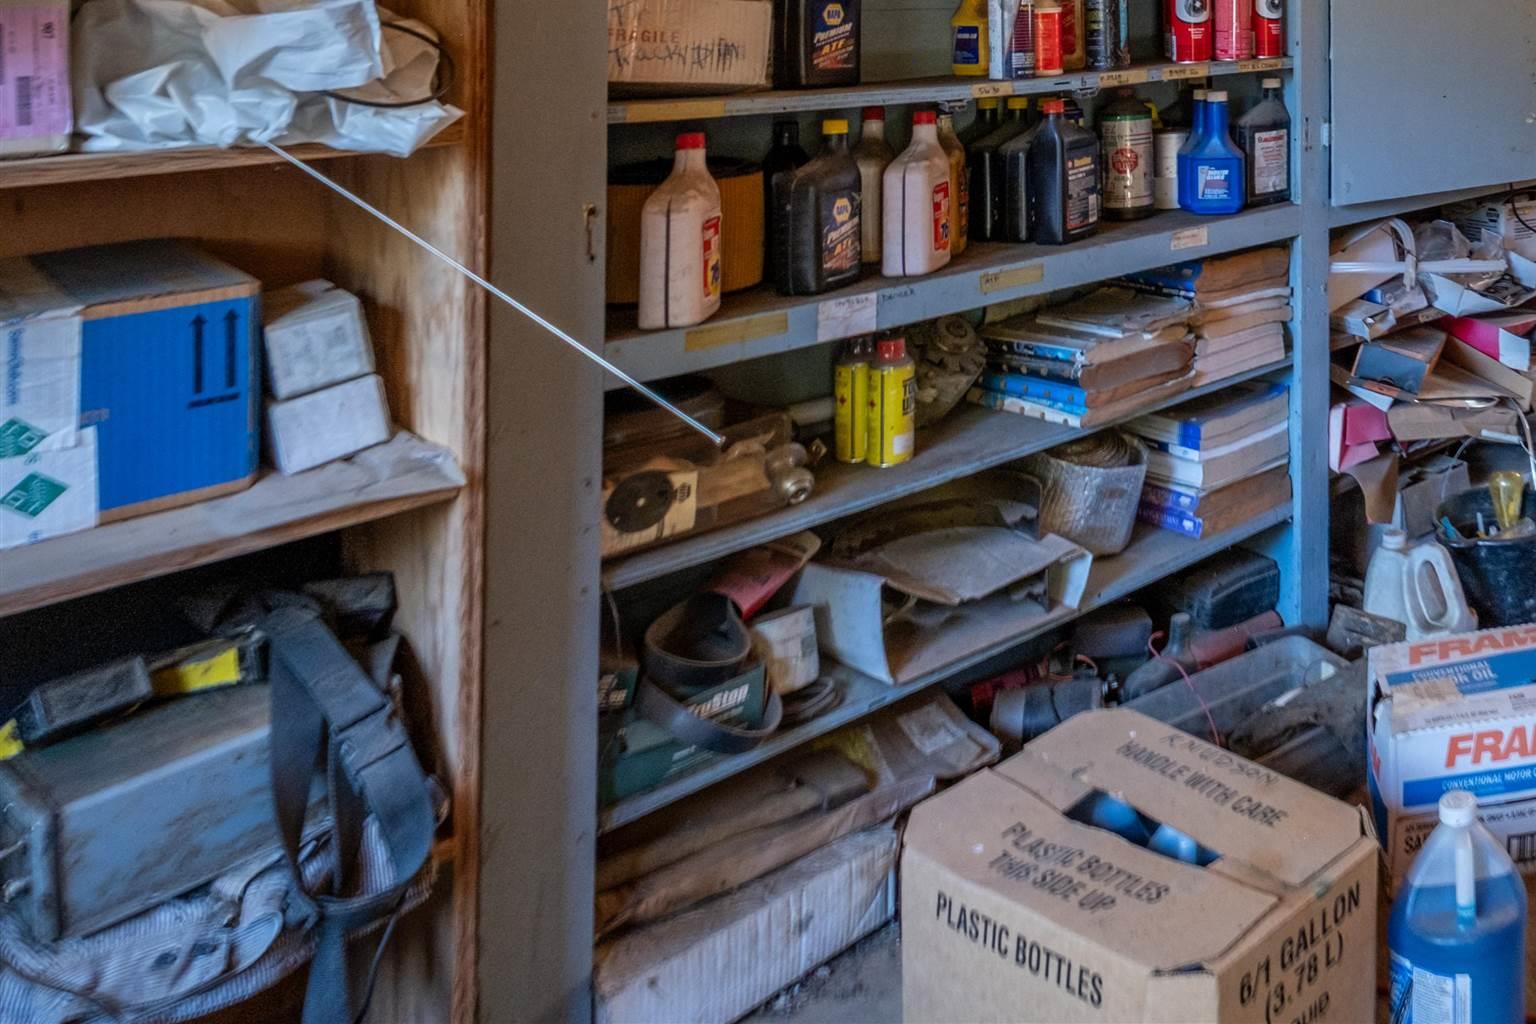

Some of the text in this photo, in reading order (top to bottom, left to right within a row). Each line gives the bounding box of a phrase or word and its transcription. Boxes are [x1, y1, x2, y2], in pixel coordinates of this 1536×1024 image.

[608, 29, 680, 43] FRAGILE
[1412, 660, 1490, 682] CONVENTIONAL
[1472, 669, 1498, 684] OIL
[1116, 740, 1289, 827] HANDLE WITH CARE
[1161, 733, 1280, 787] KNUDSON
[1442, 773, 1502, 791] CONVENTIONAL
[1504, 769, 1532, 782] MOTOR
[988, 849, 1118, 913] THIS SIDE UP
[1001, 821, 1171, 905] PLASTIC BOTTLES
[936, 891, 1104, 1009] PLASTIC BOTTLES
[1239, 880, 1362, 1007] 6/1 GALLON
